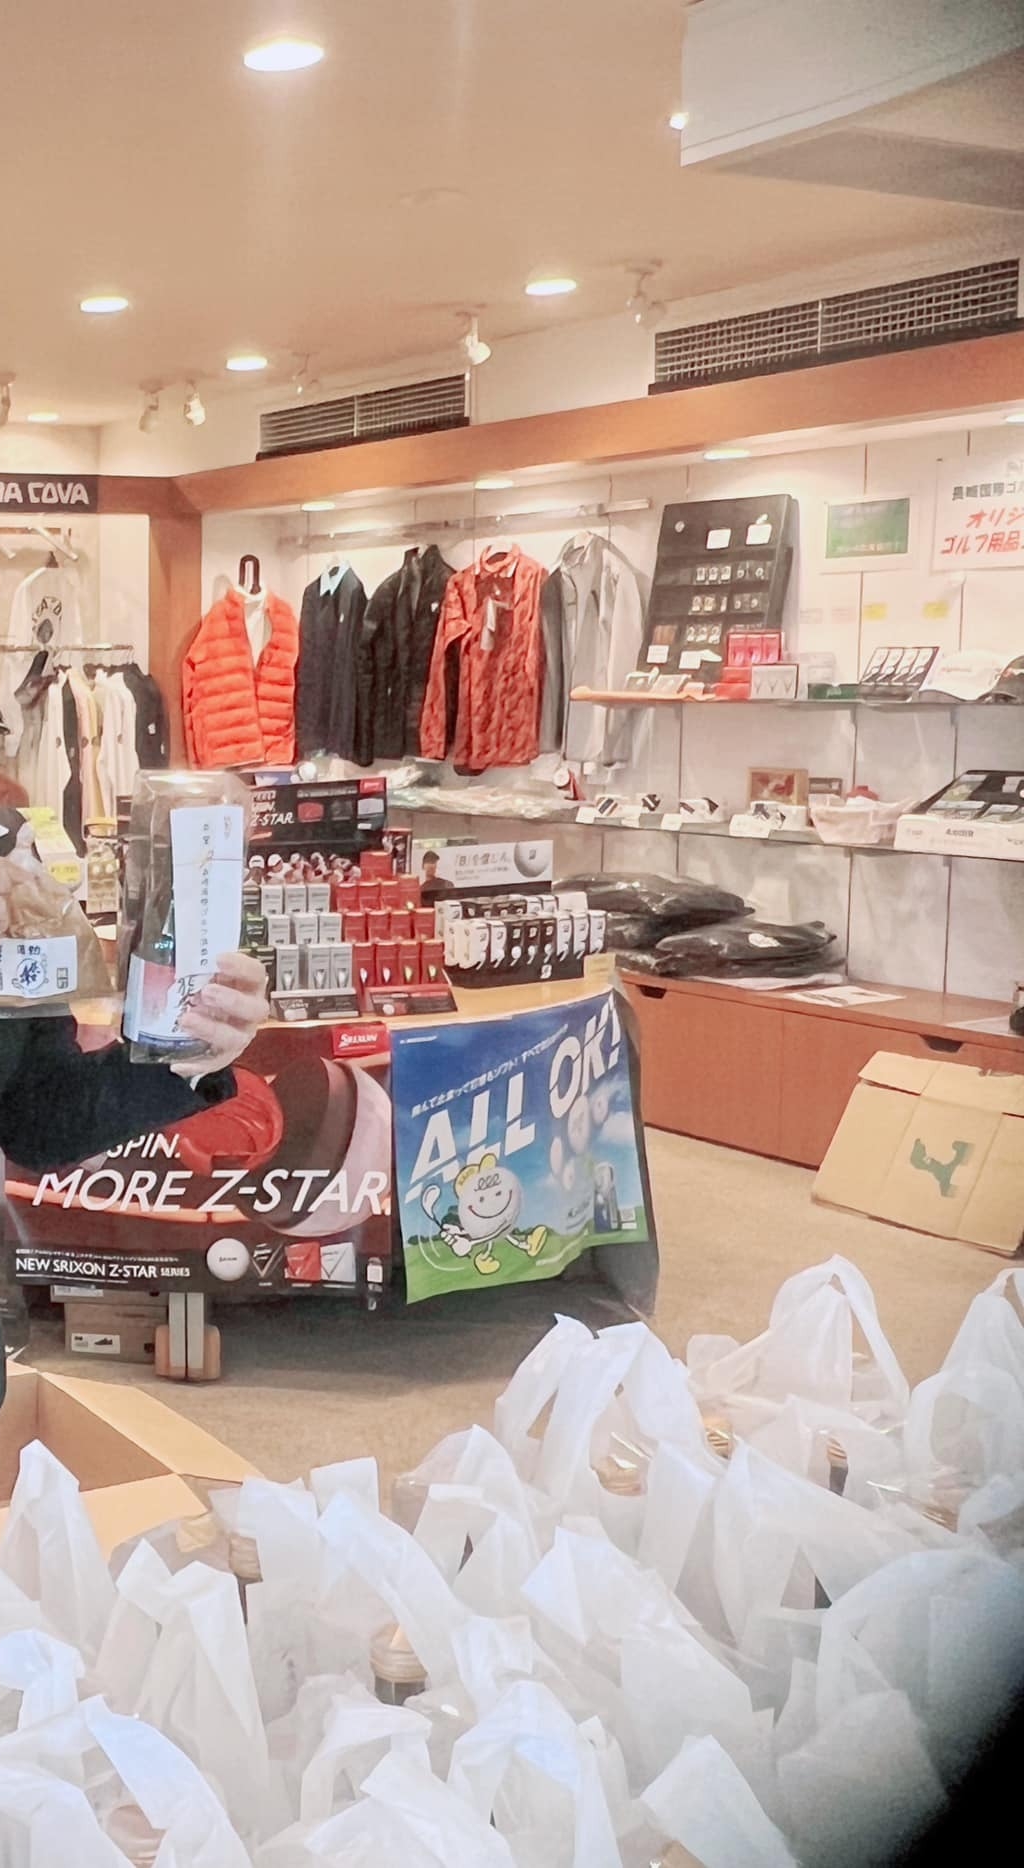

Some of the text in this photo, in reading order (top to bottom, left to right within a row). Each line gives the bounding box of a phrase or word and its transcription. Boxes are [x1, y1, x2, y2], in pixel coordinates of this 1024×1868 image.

[28, 482, 89, 504] COVA
[404, 1072, 536, 1204] ALL
[32, 1168, 392, 1216] MORE Z-STAR.
[16, 1257, 50, 1272] NEW
[53, 1259, 105, 1276] SRIXON
